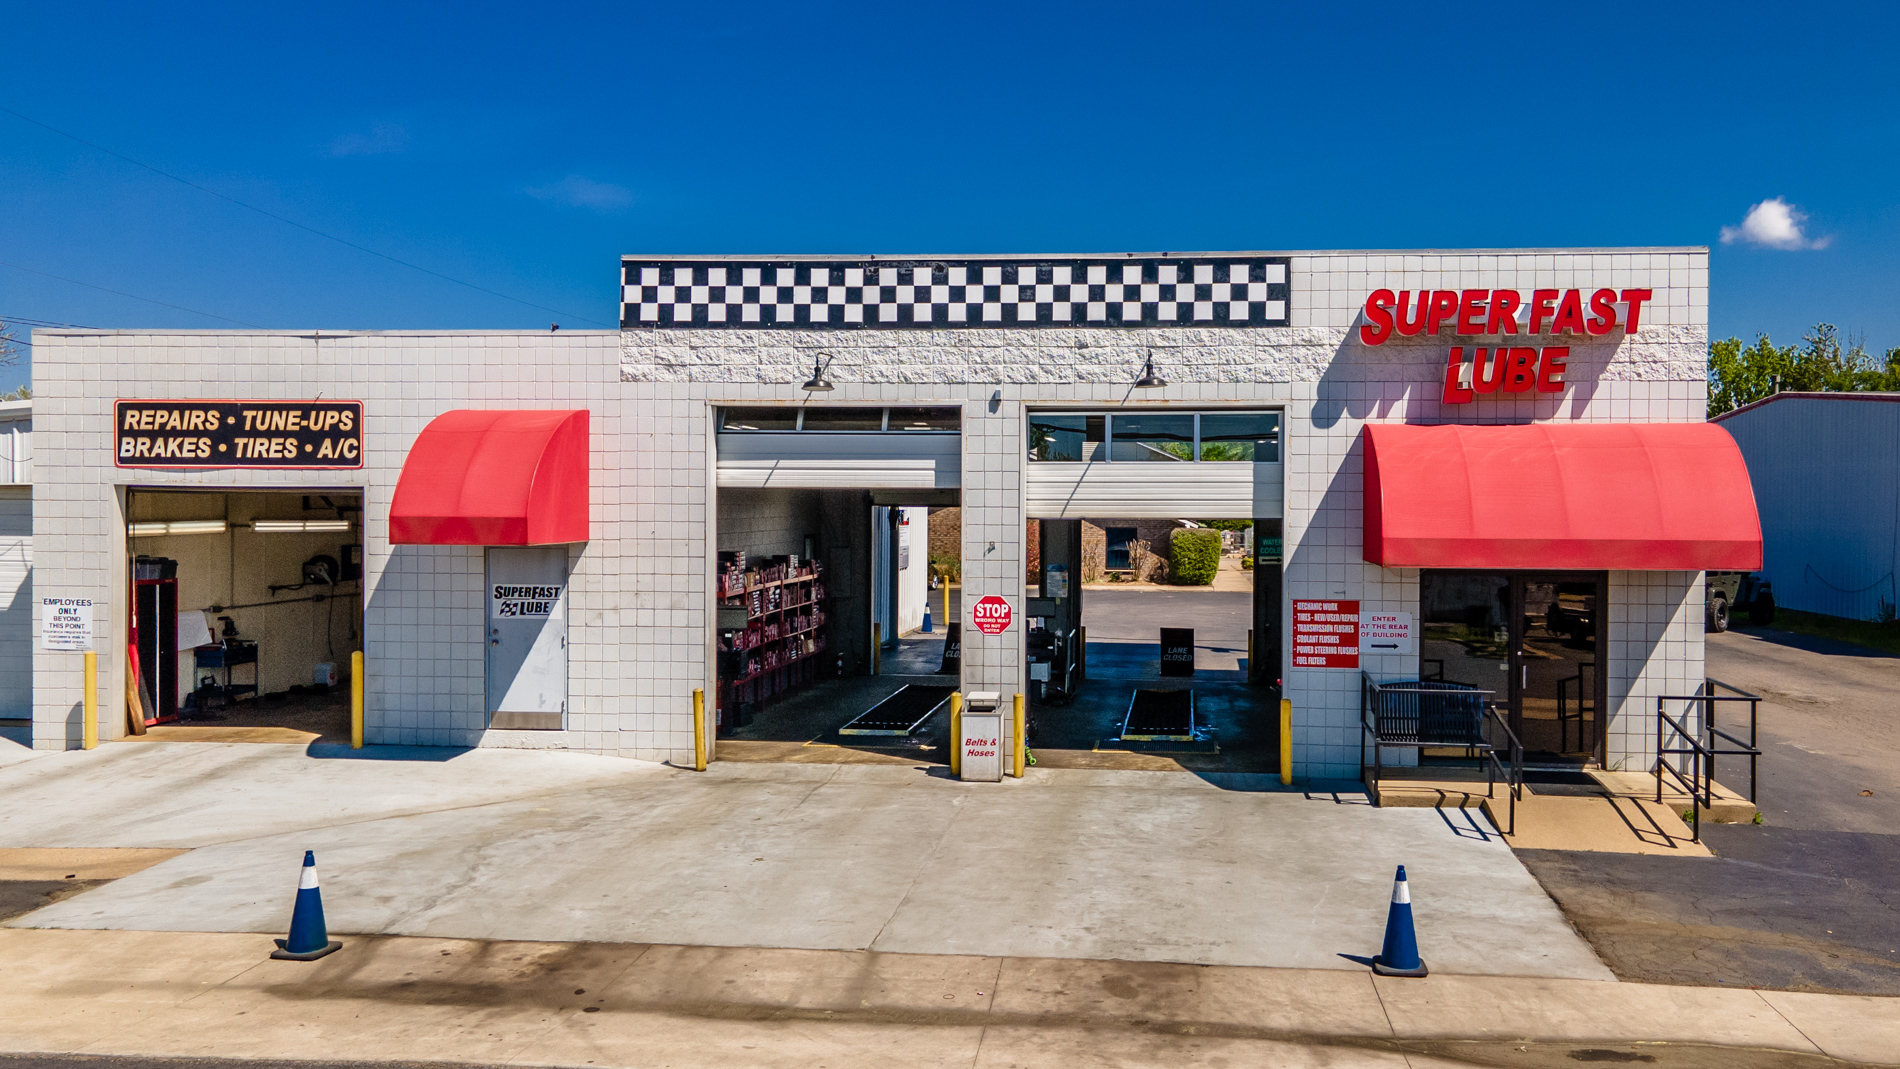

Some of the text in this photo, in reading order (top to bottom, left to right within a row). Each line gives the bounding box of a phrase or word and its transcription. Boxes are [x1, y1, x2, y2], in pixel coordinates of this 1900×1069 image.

[1442, 346, 1570, 404] LUBE
[123, 410, 354, 432] REPAIRS TUNE-UPS
[119, 437, 359, 459] BRAKES TIRES A/C
[494, 585, 560, 600] SUPERFAST
[43, 598, 92, 606] EMPLOYEES
[1297, 602, 1338, 611] MECHANIC WORK
[58, 607, 78, 615] ONLY
[519, 601, 550, 615] LUBE
[976, 603, 1009, 618] STOP
[1297, 613, 1311, 621] TIRES
[1297, 624, 1354, 633] TRANSMISSION FLUSHES
[1297, 635, 1340, 644] COOLANT FLUSHES
[1297, 646, 1358, 655] POWER STEERING FLUSHES
[1297, 656, 1326, 665] FUEL FILTERS
[965, 738, 997, 746] Belts &
[967, 749, 995, 757] Hoses
